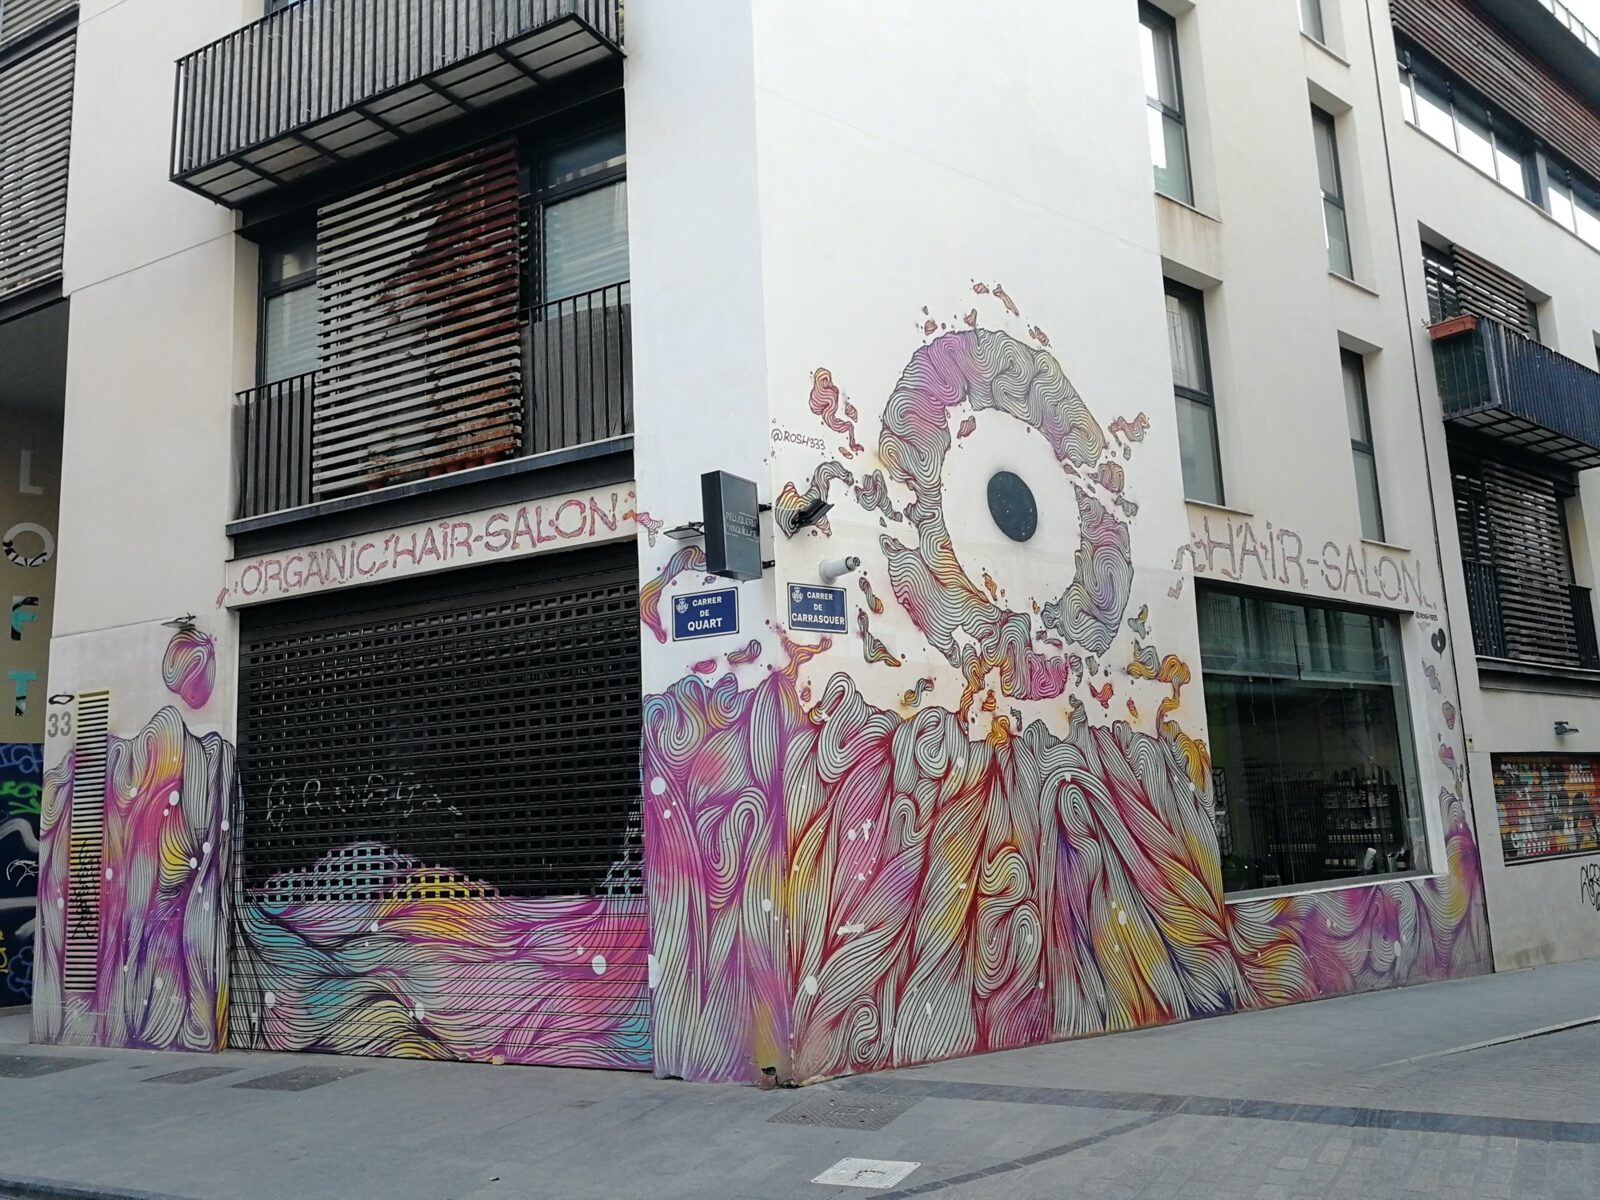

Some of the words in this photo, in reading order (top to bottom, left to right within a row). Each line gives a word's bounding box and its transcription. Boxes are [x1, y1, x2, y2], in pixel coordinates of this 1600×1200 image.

[239, 540, 377, 597] ORGANIC
[692, 596, 722, 608] CARRER
[806, 591, 834, 601] CARRER
[699, 609, 710, 618] DE
[813, 603, 823, 612] DE
[687, 617, 723, 632] QUART
[791, 612, 845, 626] CARRASQUER
[47, 711, 72, 738] 33
